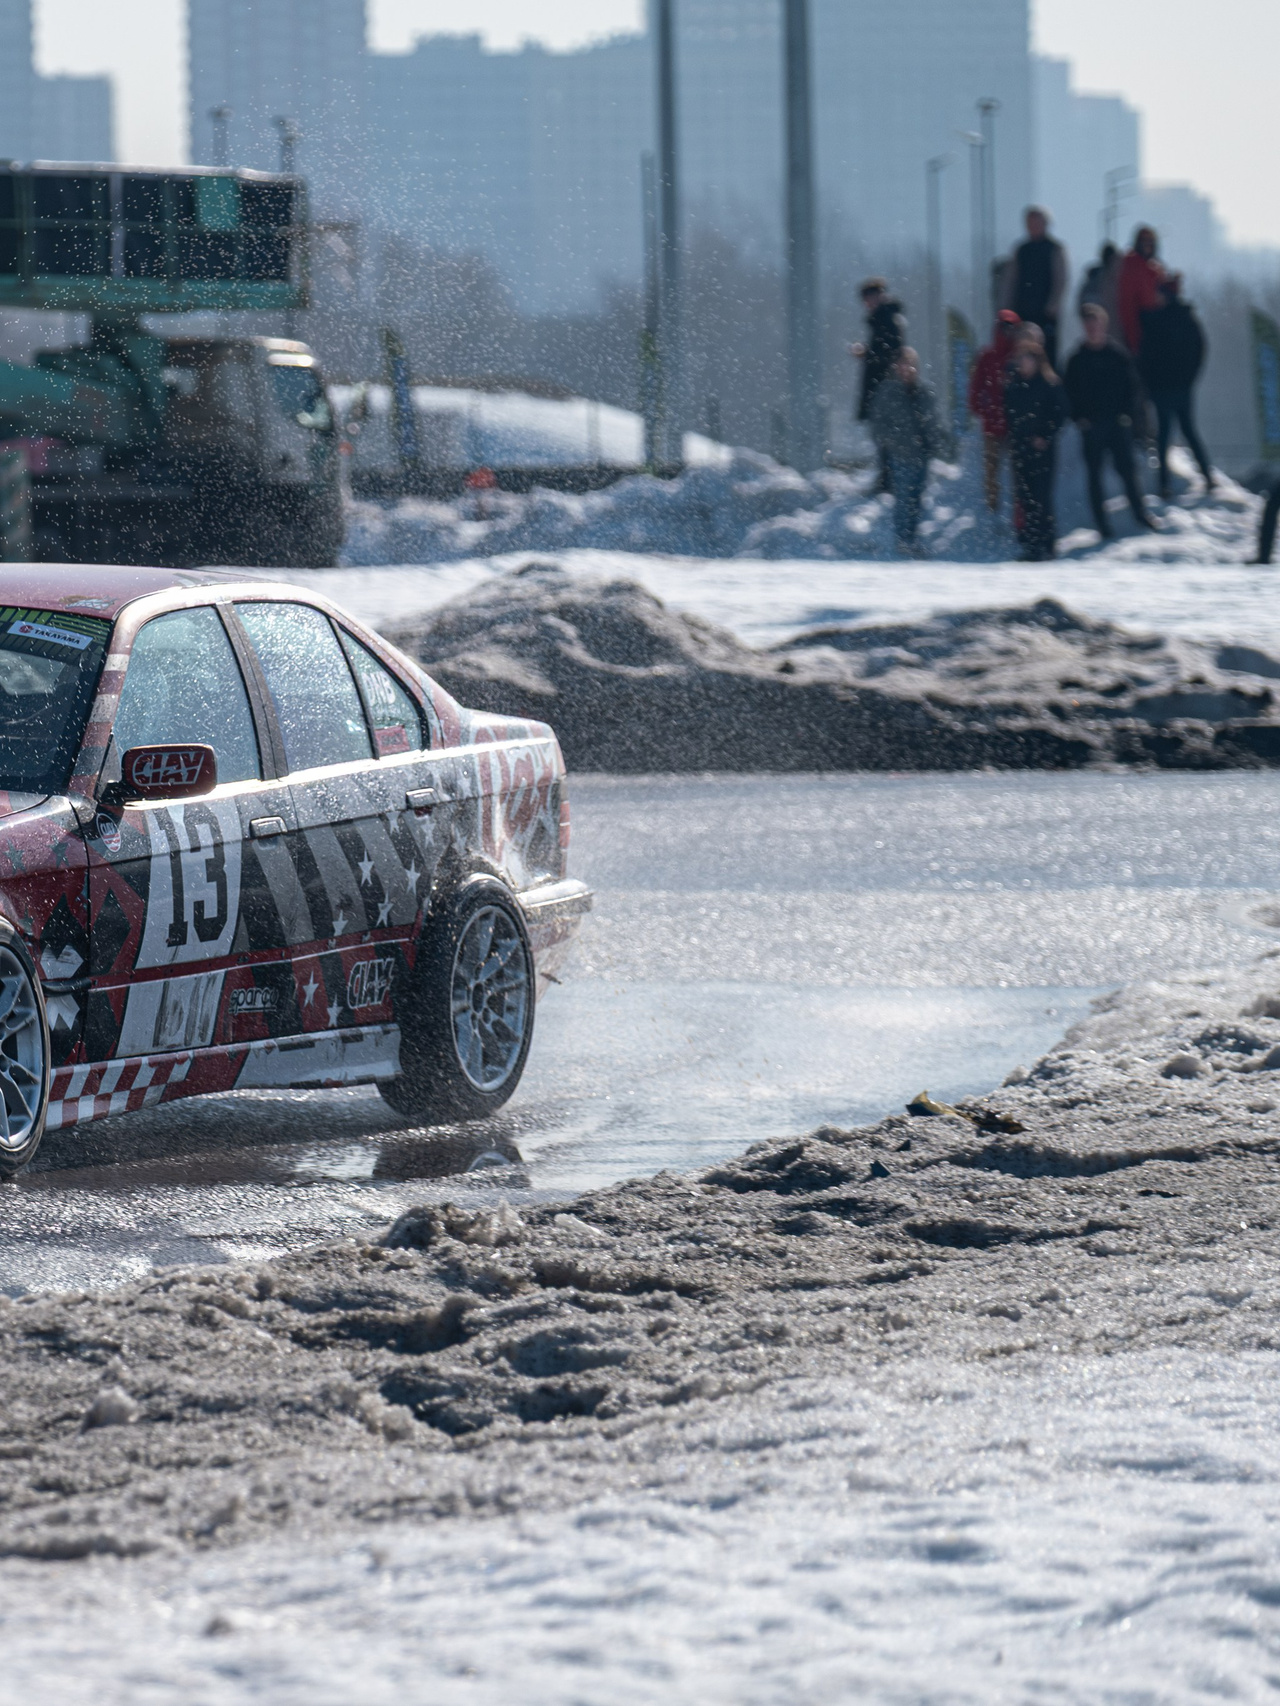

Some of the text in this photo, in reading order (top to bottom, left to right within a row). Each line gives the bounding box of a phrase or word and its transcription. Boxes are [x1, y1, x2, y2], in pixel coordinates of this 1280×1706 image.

[34, 629, 81, 645] TAKAYAMA
[151, 801, 229, 948] 13
[229, 986, 280, 1015] sparco
